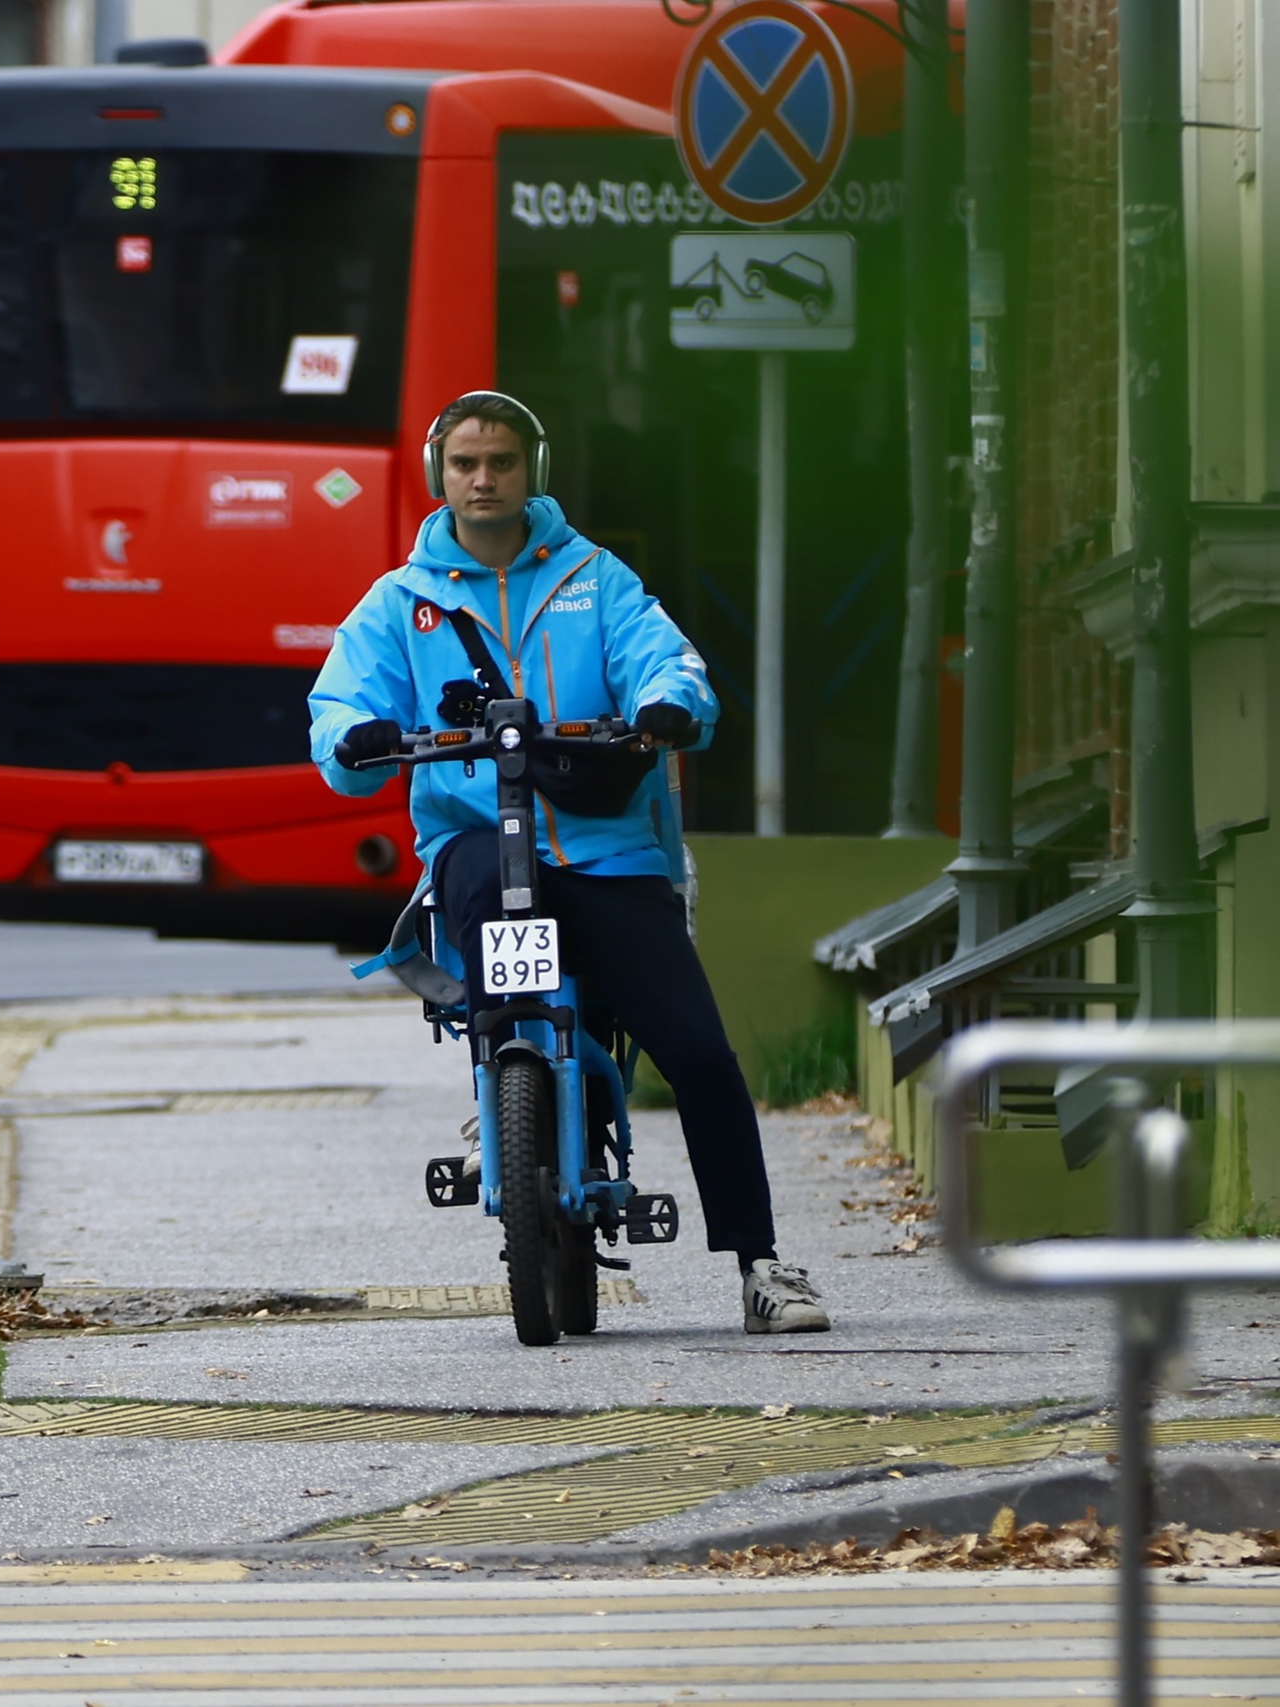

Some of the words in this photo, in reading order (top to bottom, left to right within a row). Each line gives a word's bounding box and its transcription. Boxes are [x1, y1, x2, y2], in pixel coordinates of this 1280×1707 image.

[559, 578, 599, 597] декс
[418, 606, 433, 628] Я
[489, 925, 550, 953] УУ3
[491, 959, 553, 987] 89Р
